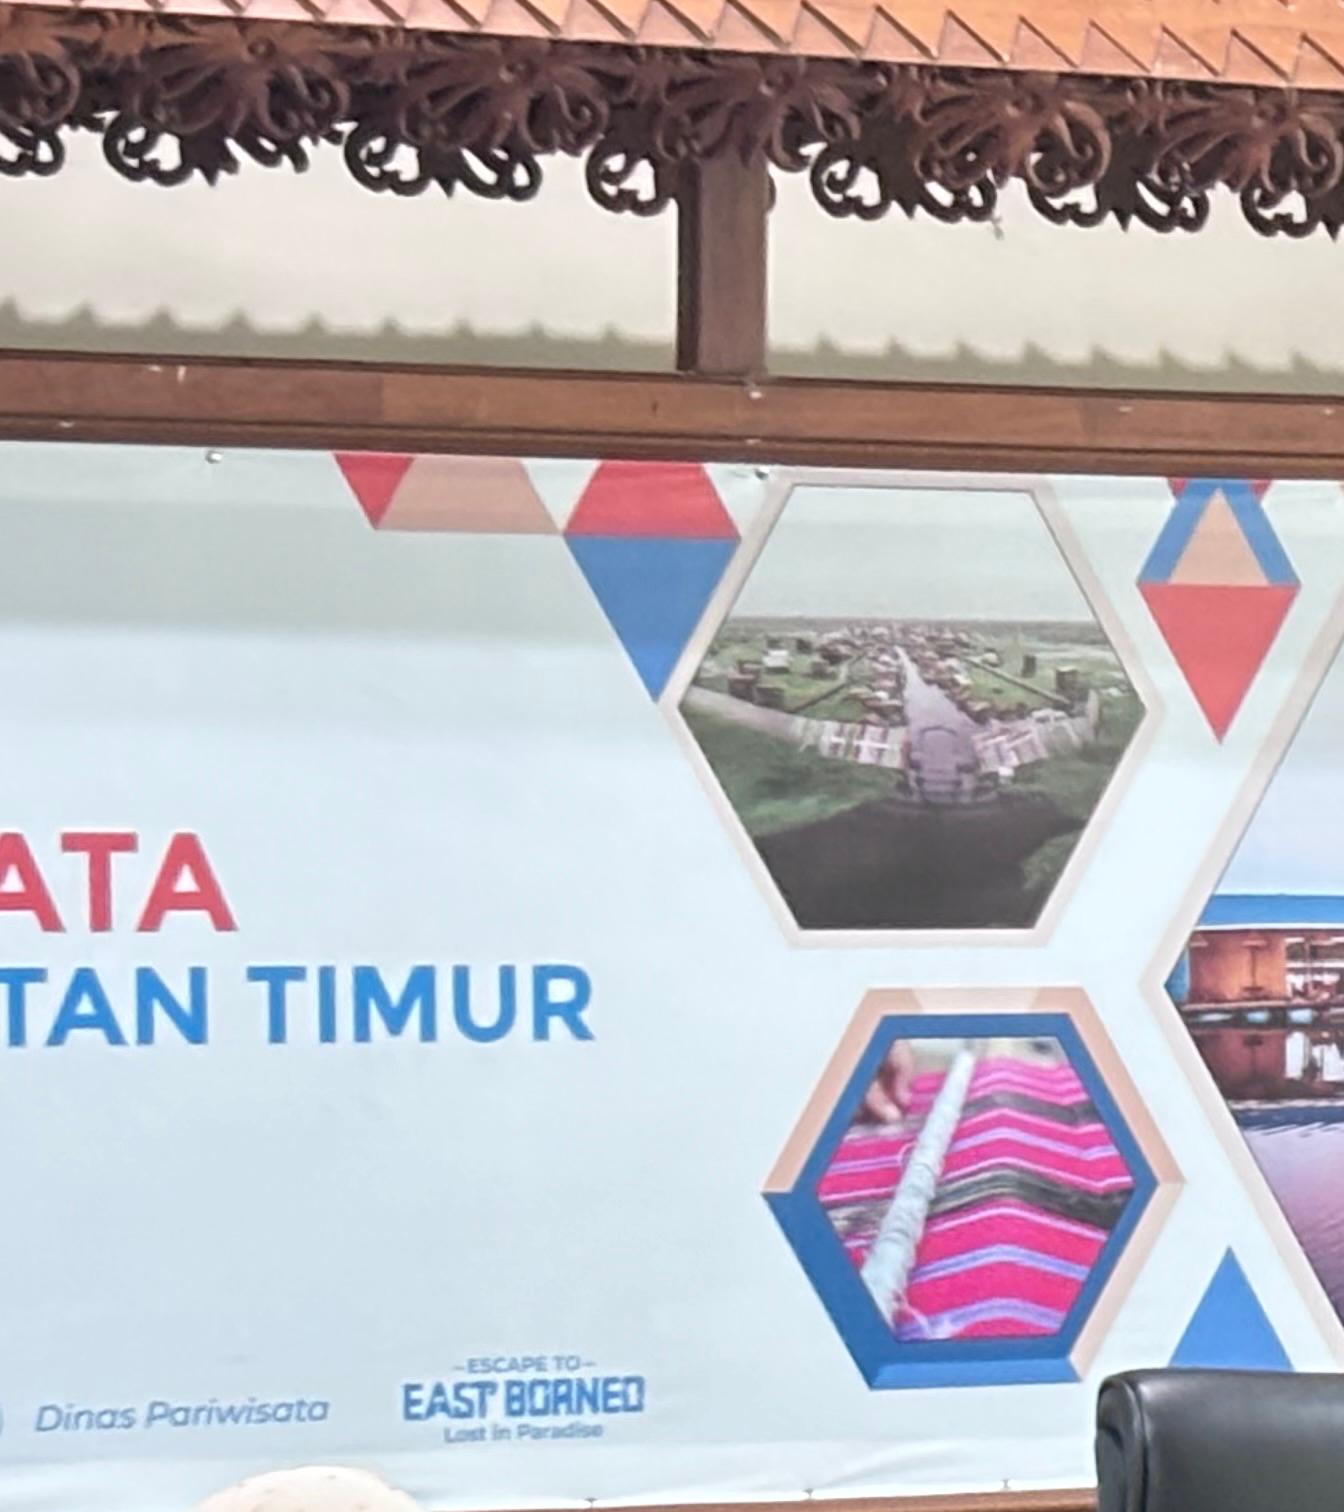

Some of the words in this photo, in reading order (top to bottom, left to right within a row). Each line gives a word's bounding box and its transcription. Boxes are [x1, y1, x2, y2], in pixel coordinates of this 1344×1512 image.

[0, 832, 239, 933] ATA
[0, 966, 208, 1047] TAN
[246, 964, 595, 1044] TIMUR
[35, 1403, 136, 1432] Dinas
[145, 1397, 330, 1428] Pariwisata
[403, 1380, 497, 1421] EAST
[504, 1375, 645, 1418] BORNEO
[443, 1425, 486, 1443] Lost
[491, 1423, 511, 1440] in
[516, 1421, 604, 1440] Paradise
